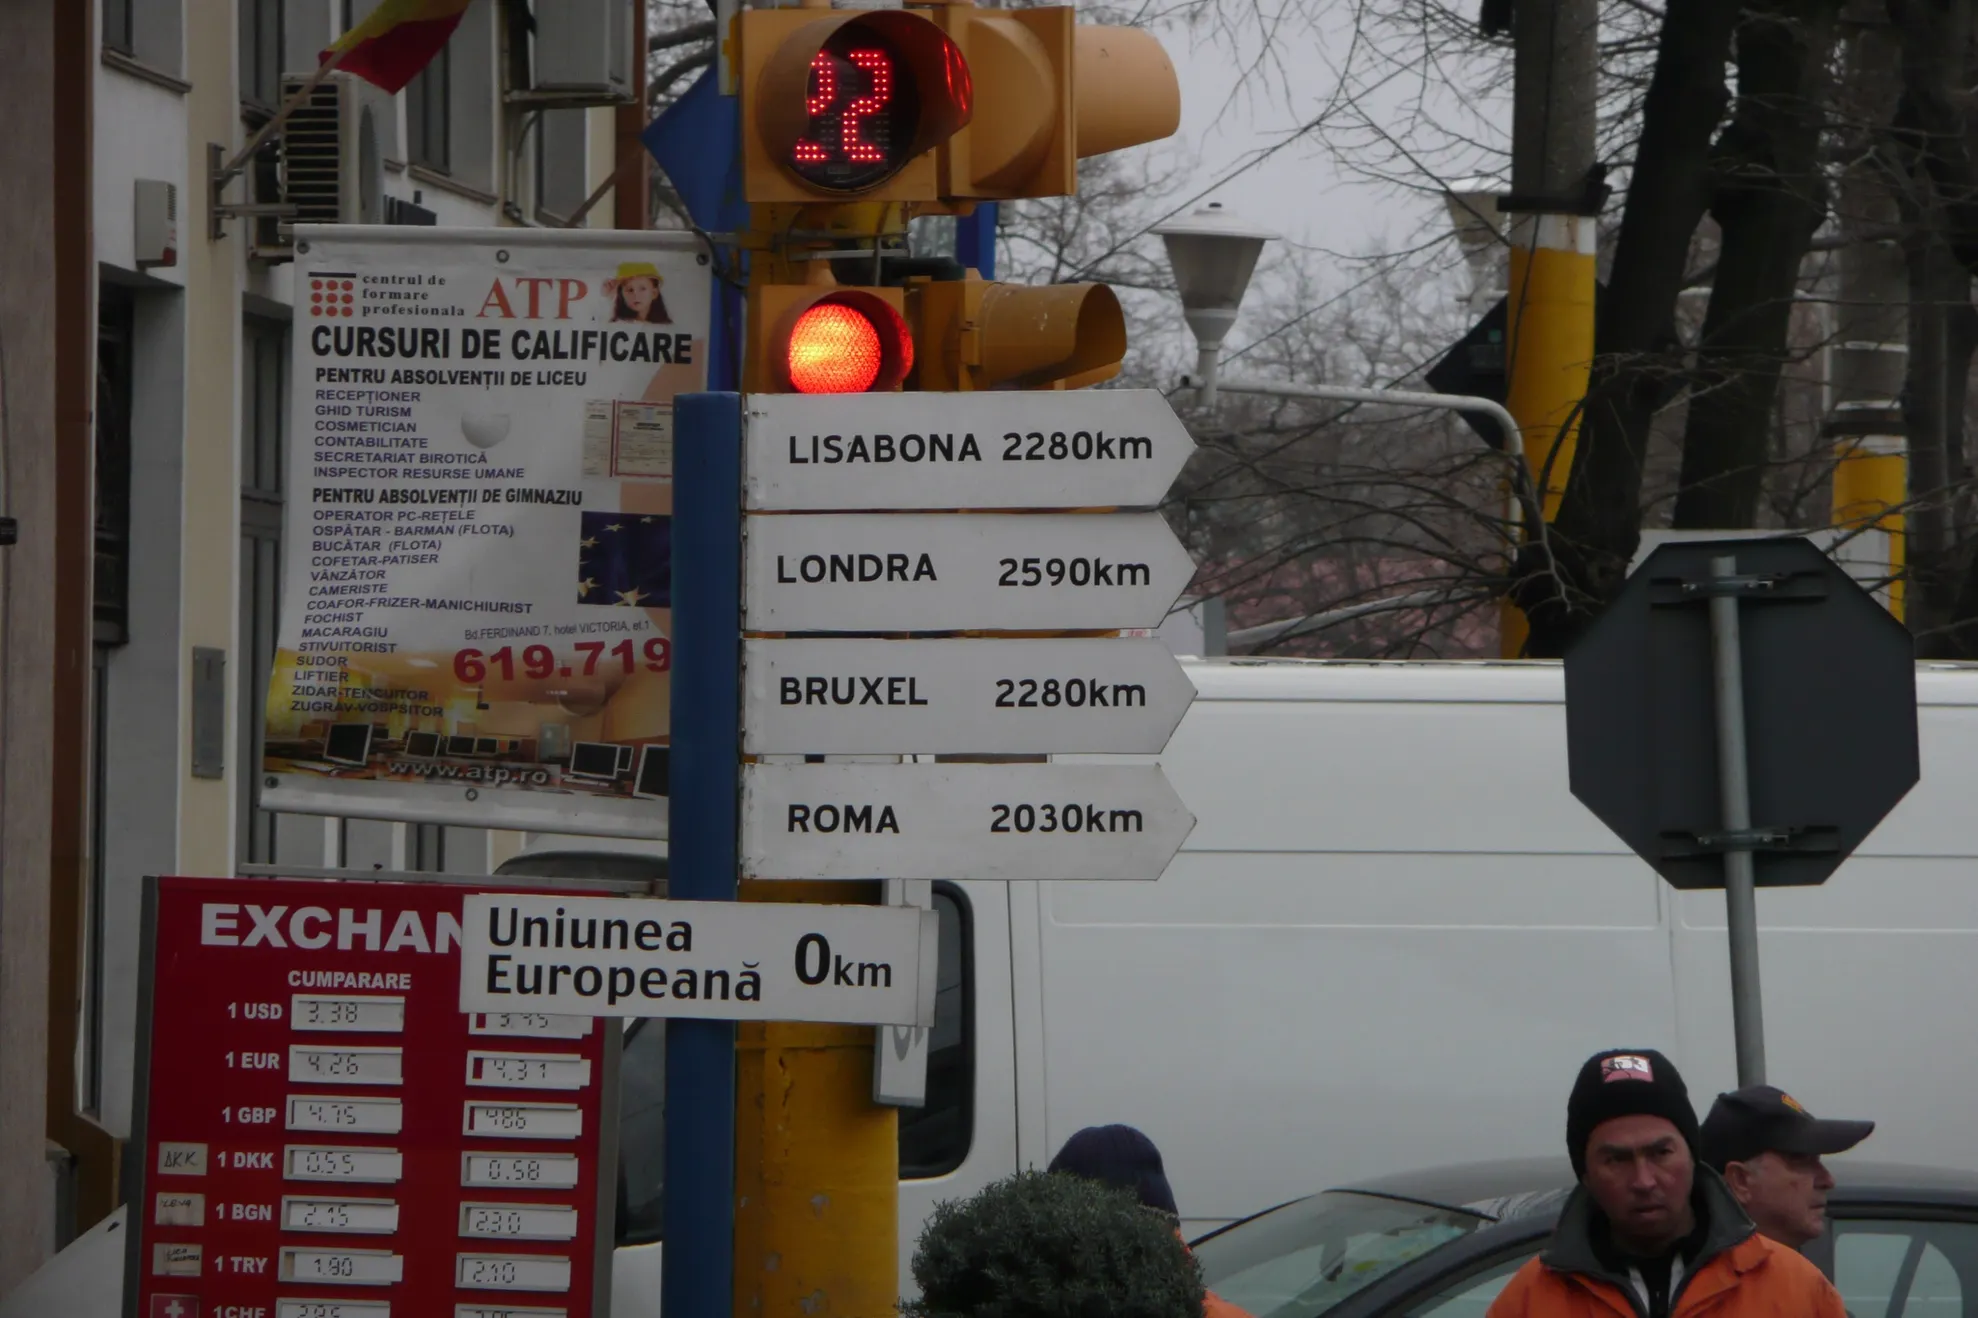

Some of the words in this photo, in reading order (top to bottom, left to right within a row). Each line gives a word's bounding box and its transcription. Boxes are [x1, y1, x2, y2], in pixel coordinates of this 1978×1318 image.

[363, 274, 422, 286] centrul
[428, 275, 446, 286] de
[362, 288, 429, 300] formare
[476, 276, 589, 320] ATP
[362, 304, 465, 317] profesionala
[311, 325, 450, 359] CURSURI
[461, 328, 501, 360] DE
[511, 329, 693, 365] CALIFICARE
[315, 367, 386, 384] PENTRU
[510, 370, 532, 387] DE
[536, 370, 587, 387] LICEU
[315, 405, 352, 417] GHID
[356, 405, 412, 418] TURISM
[314, 420, 417, 433] COSMETICIAN
[314, 435, 429, 449] CONTABILITATE
[788, 432, 982, 464] LISABONA
[1001, 430, 1153, 462] 2280km
[314, 451, 416, 464] SECRETARIAT
[314, 466, 398, 479] INSPECTOR
[402, 467, 471, 480] RESURSE
[475, 467, 525, 479] UMANE
[312, 487, 374, 504] PENTRU
[482, 488, 501, 504] DE
[505, 488, 582, 506] GIMNAZIU
[313, 510, 394, 522] OPERATOR
[394, 524, 454, 537] BARMAN
[458, 524, 515, 538] (FLOTA)
[388, 539, 442, 553] (FLOTA)
[311, 553, 439, 567] COFETAR-PATISER
[776, 553, 938, 583] LONDRA
[997, 557, 1151, 587] 2590km
[308, 583, 388, 596] CAMERISTE
[304, 612, 364, 624] FOCHIST
[301, 626, 388, 639] MACARAGIU
[298, 641, 398, 654] STIVUITORIST
[296, 655, 348, 667] SUDOR
[453, 637, 671, 684] 619.719
[294, 670, 349, 682] LIFTIER
[779, 676, 929, 706] BRUXEL
[994, 677, 1147, 708] 2280km
[387, 760, 550, 788] www.atp.ro
[787, 803, 900, 834] ROMA
[990, 802, 1144, 833] 2030km
[488, 906, 693, 952] Uniunea
[287, 969, 412, 990] CUMPARARE
[486, 953, 762, 1006] Europeană
[227, 1001, 237, 1019] 1
[243, 1002, 283, 1020] USD
[225, 1051, 235, 1069] 1
[240, 1052, 281, 1070] EUR
[221, 1106, 231, 1123] 1
[237, 1107, 277, 1124] GBP
[217, 1151, 227, 1168] 1
[233, 1152, 275, 1169] DKK
[488, 1159, 540, 1181] 0.58
[215, 1203, 225, 1220] 1
[231, 1204, 272, 1221] BGN
[214, 1256, 223, 1273] 1
[230, 1256, 269, 1274] TRY
